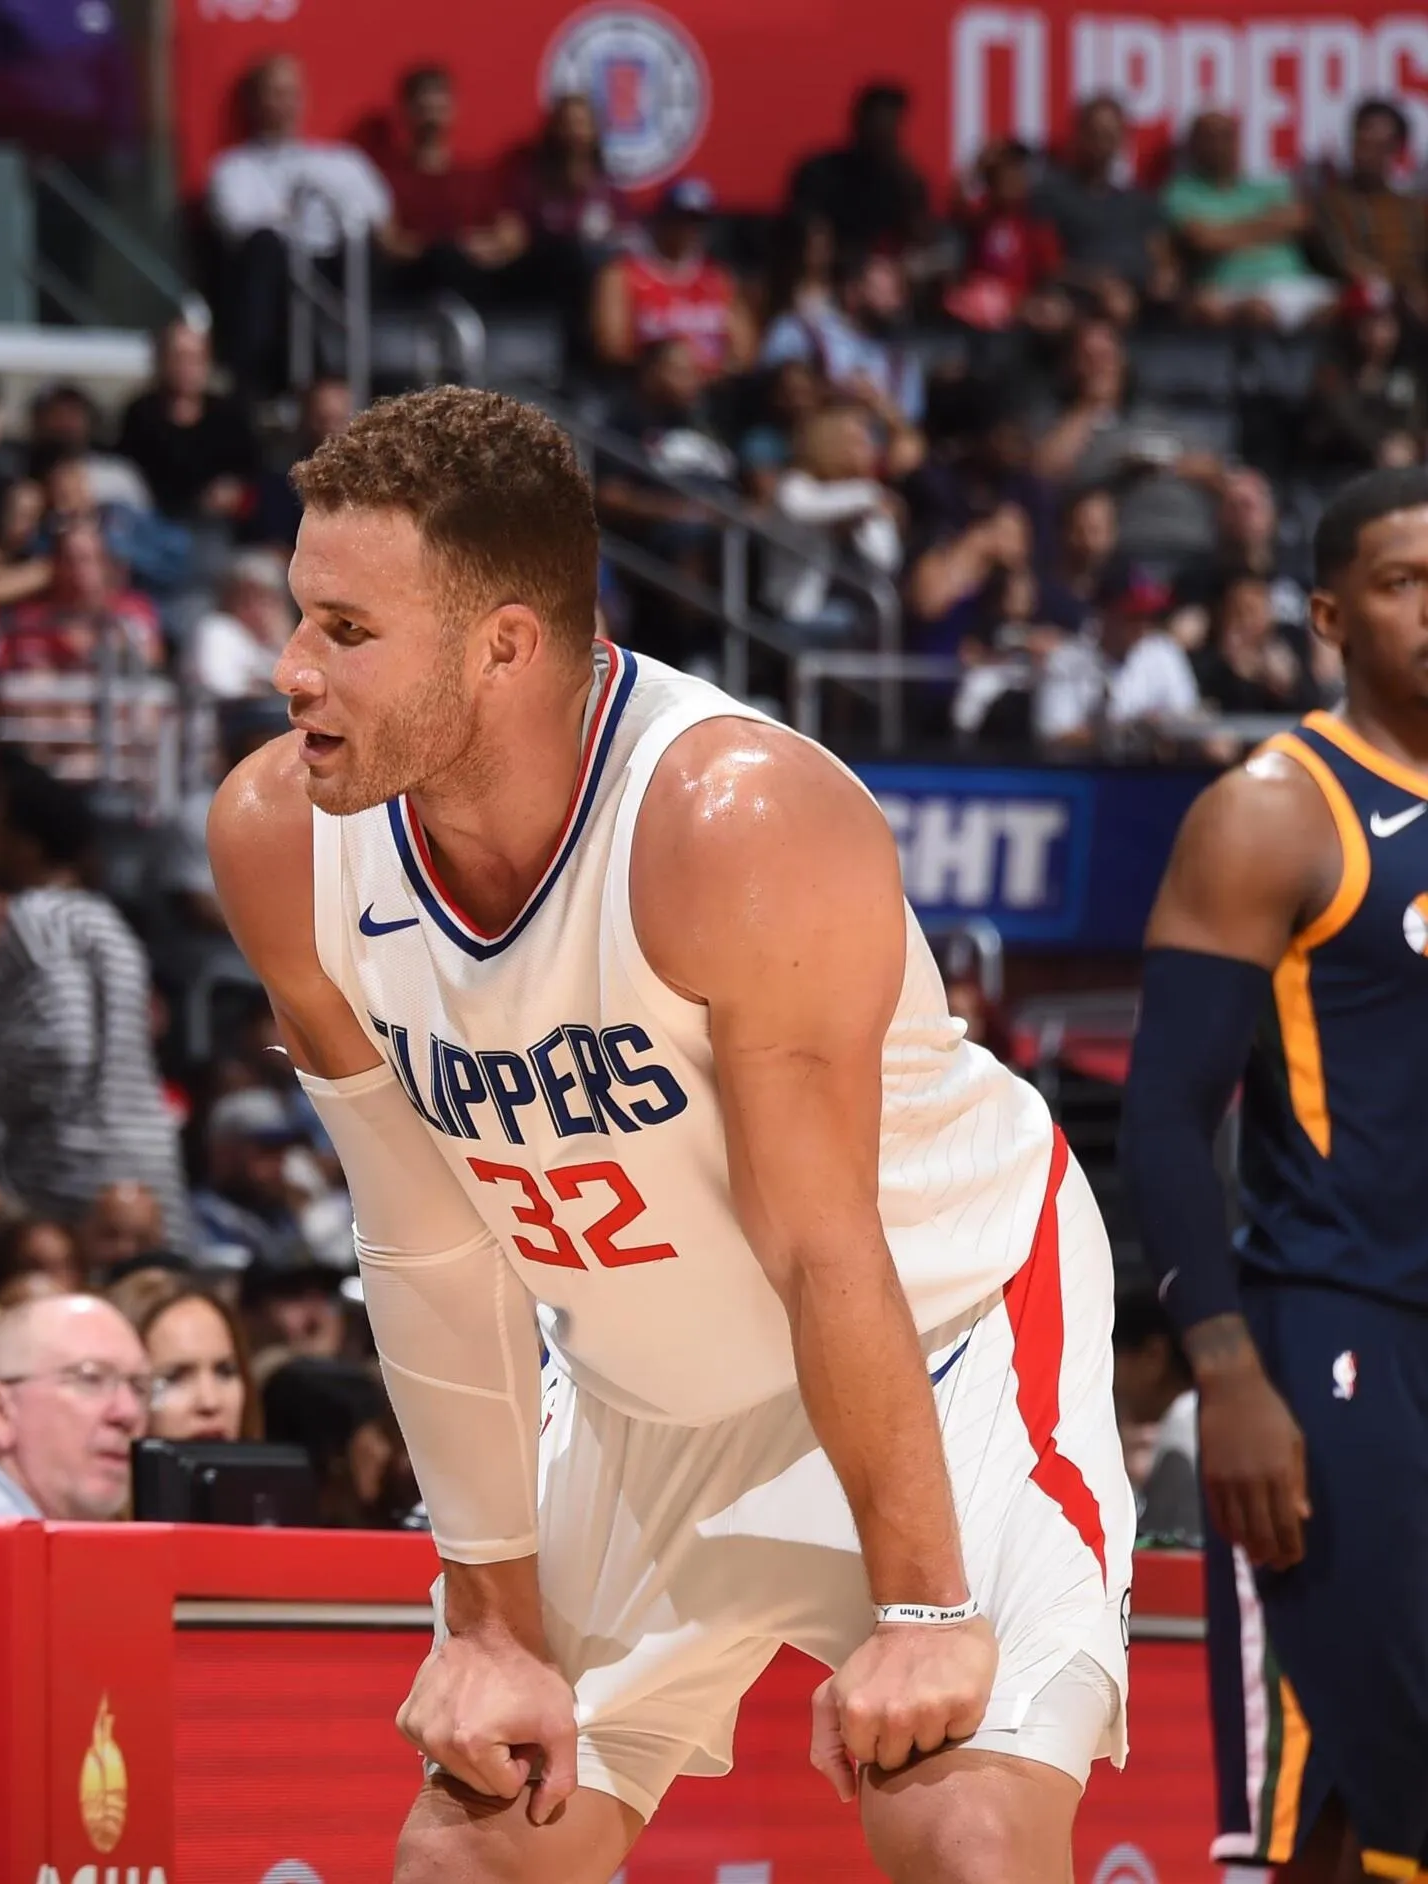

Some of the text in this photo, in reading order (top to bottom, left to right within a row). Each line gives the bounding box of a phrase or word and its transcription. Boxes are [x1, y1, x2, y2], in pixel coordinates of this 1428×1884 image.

[466, 1157, 680, 1271] 32
[899, 1608, 924, 1619] finn
[940, 1609, 965, 1620] ford
